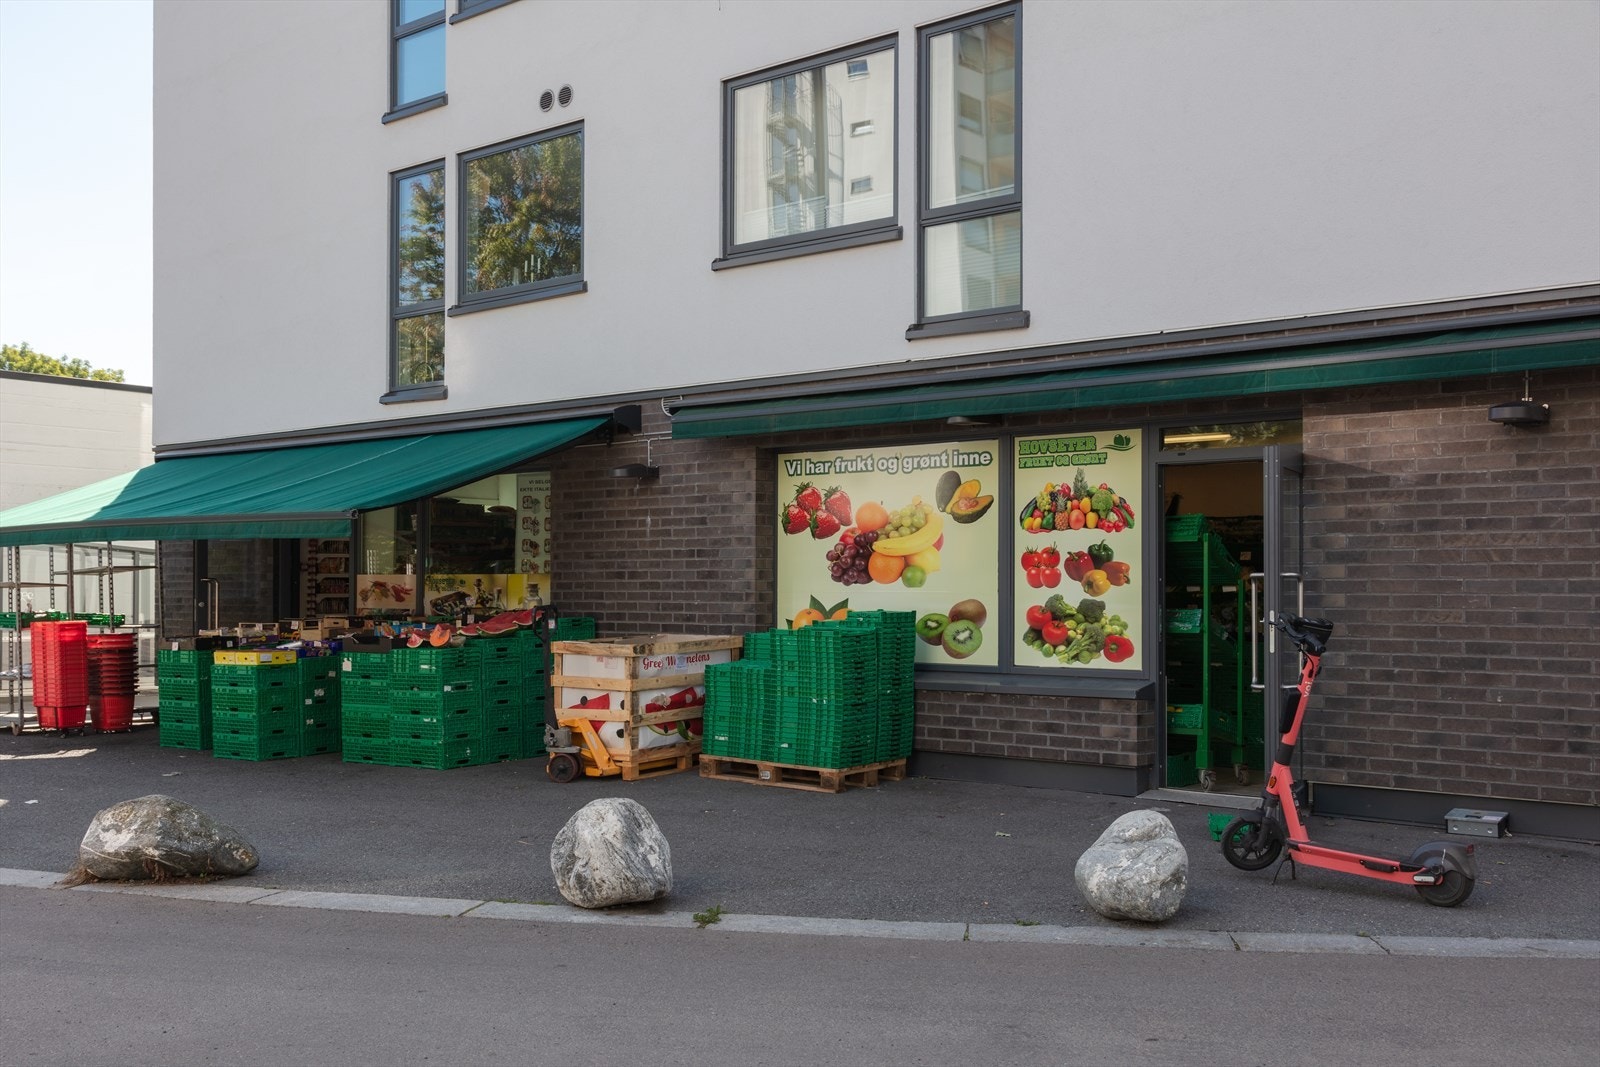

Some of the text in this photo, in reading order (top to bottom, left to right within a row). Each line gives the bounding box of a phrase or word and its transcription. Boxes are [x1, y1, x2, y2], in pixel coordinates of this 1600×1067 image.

[1019, 436, 1096, 455] HOVSETER
[785, 449, 993, 477] Vi har frukt og grønt inne
[1019, 452, 1107, 469] FRUKT OG GRØNT
[643, 657, 664, 670] Gree
